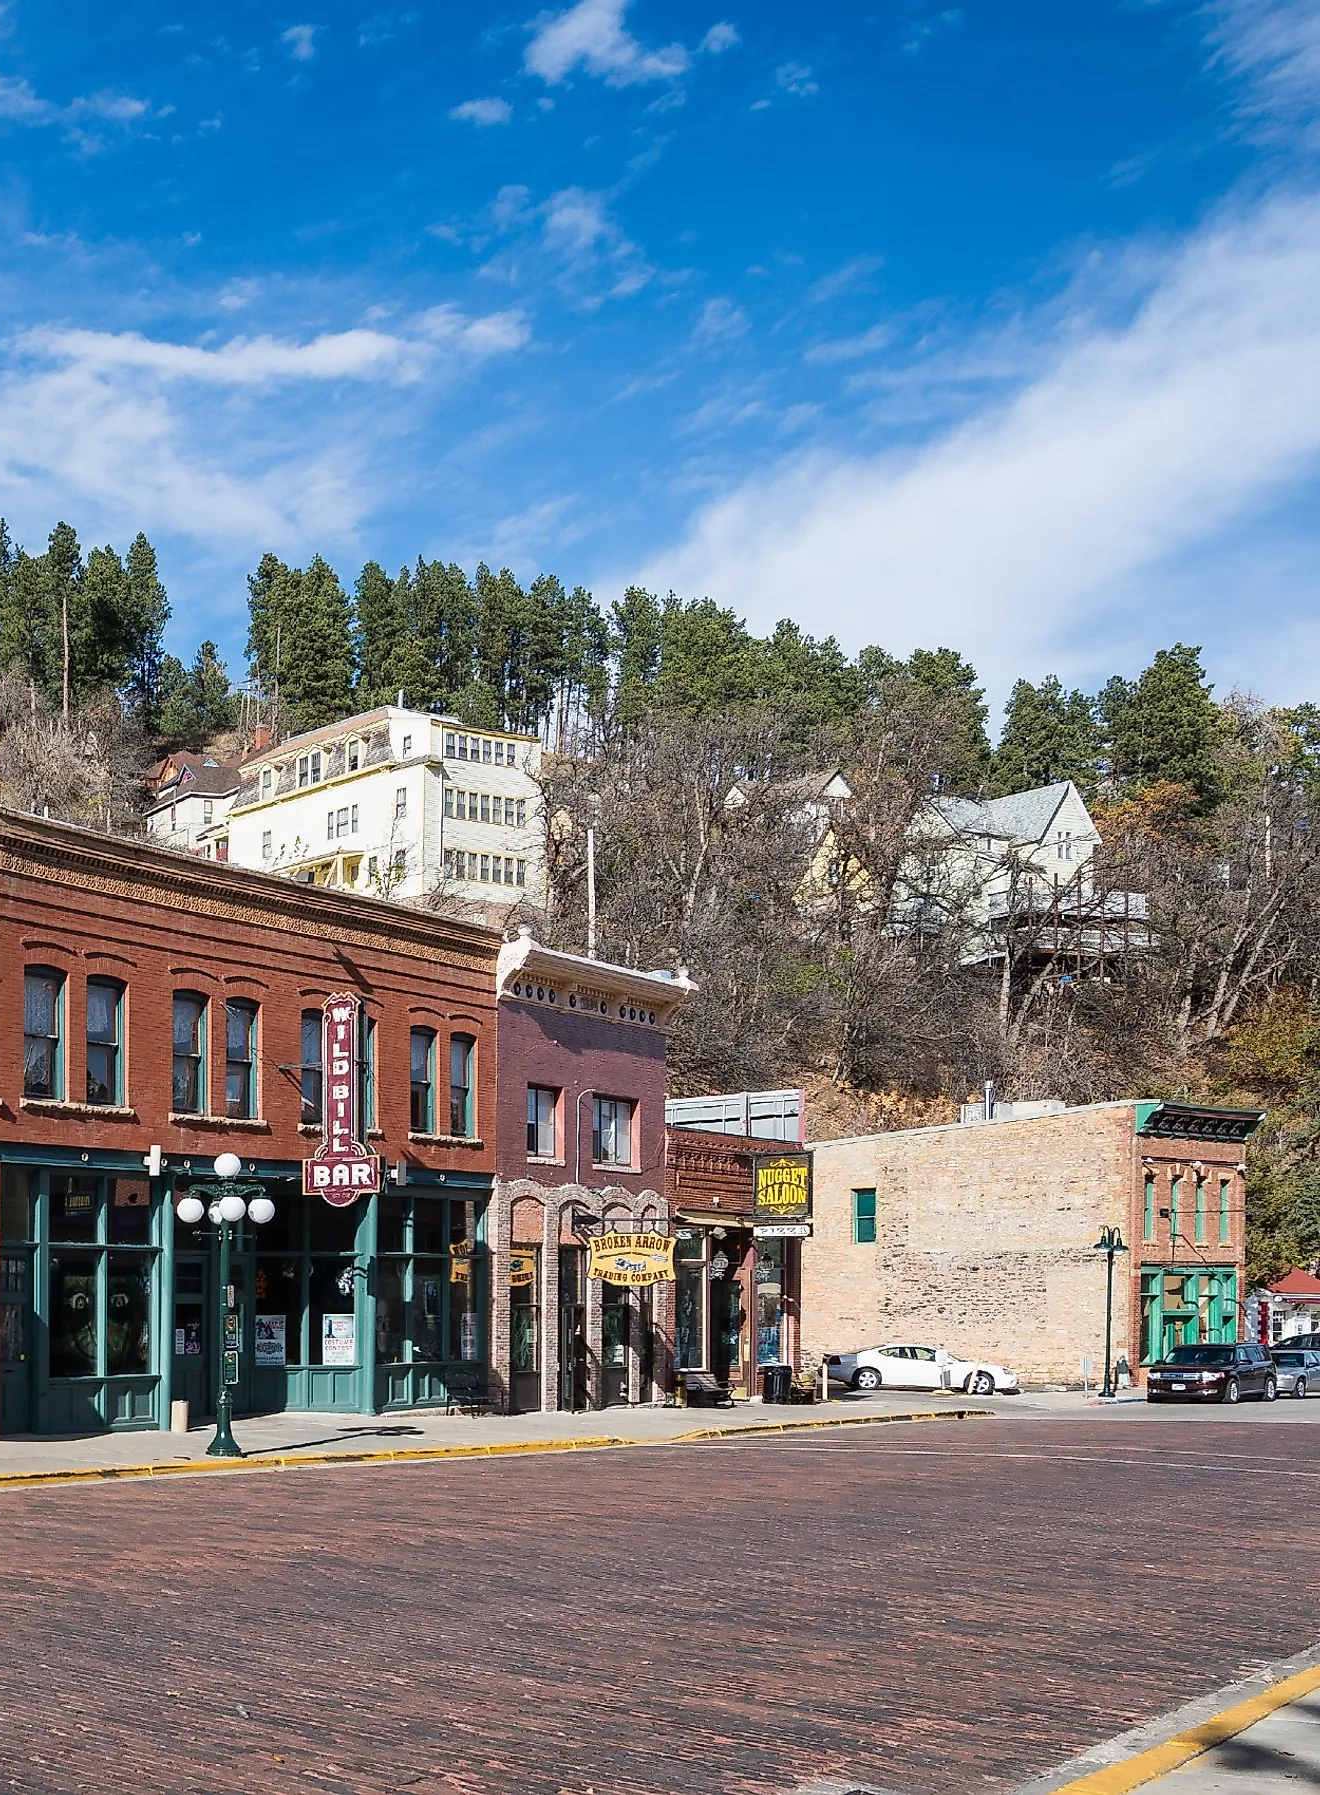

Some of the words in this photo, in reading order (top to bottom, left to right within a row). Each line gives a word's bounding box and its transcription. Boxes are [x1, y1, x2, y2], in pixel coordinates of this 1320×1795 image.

[332, 1007, 351, 1075] WILD
[332, 1085, 350, 1152] BILL
[313, 1164, 372, 1188] BAR
[758, 1167, 808, 1190] NUGGET
[758, 1184, 807, 1206] SALOON
[760, 1227, 808, 1235] PIZZA
[593, 1236, 631, 1252] BROKEN
[635, 1236, 671, 1252] ARROW
[593, 1268, 628, 1282] TRADING
[631, 1270, 669, 1282] COMPANY
